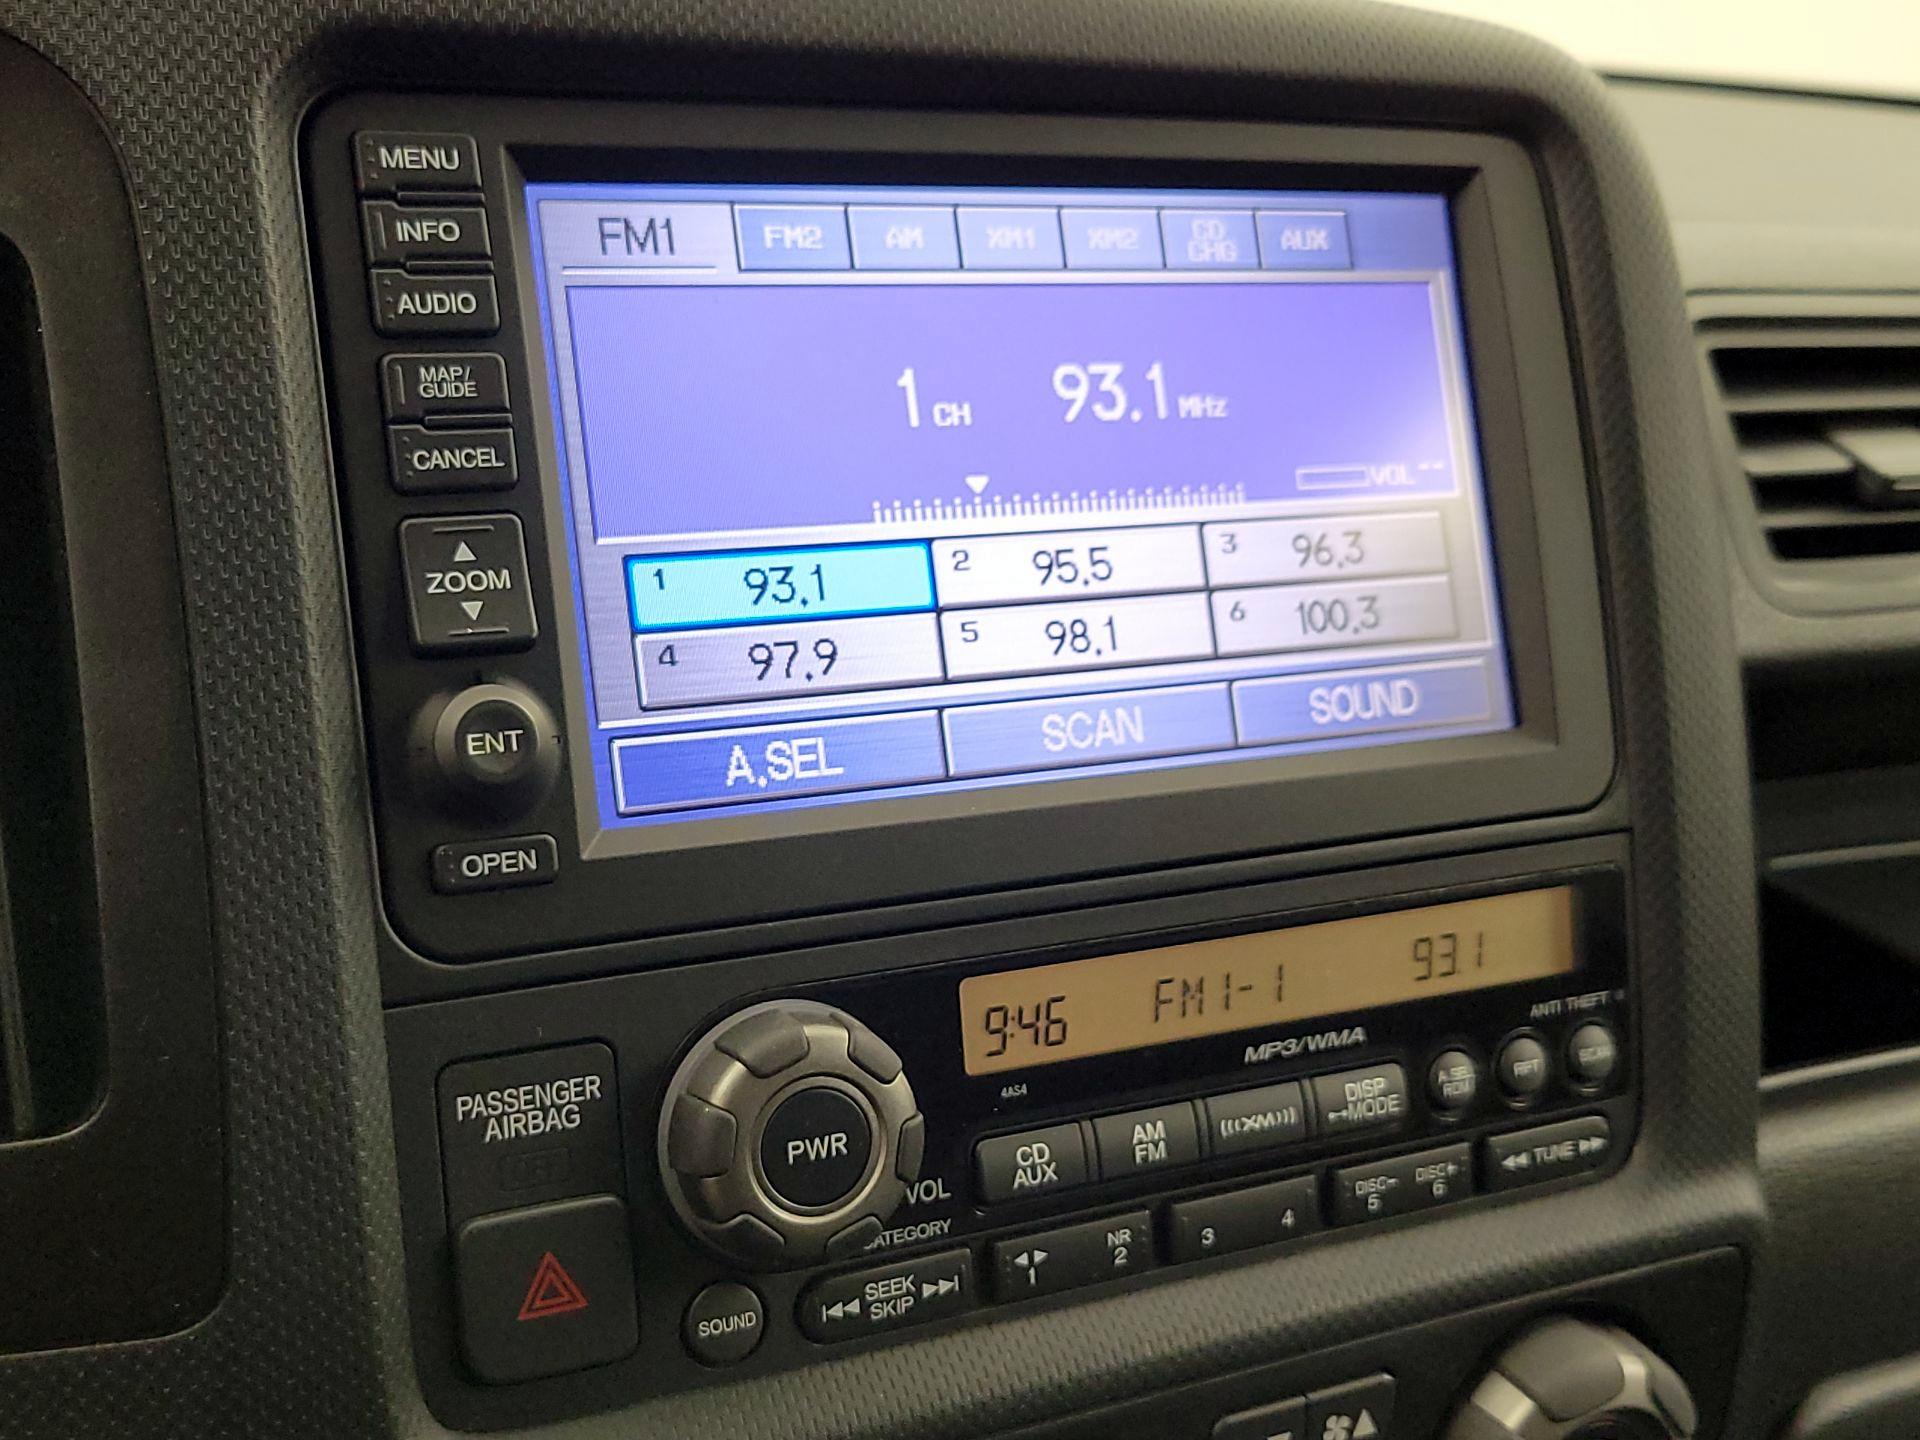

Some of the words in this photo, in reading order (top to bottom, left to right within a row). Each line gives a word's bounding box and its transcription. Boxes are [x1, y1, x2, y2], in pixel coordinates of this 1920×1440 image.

[380, 147, 460, 170] MENU
[397, 220, 461, 243] INFO
[599, 216, 676, 256] FM1
[763, 224, 823, 250] FM2
[884, 226, 925, 250] AM
[986, 227, 1036, 250] XM1
[1088, 227, 1139, 250] XM2
[1191, 218, 1226, 240] CD
[1280, 228, 1329, 251] AUX
[1188, 239, 1237, 262] CHG
[398, 292, 477, 315] AUDIO
[419, 366, 471, 384] MAP/
[419, 381, 478, 398] GUIDE
[897, 367, 920, 428] 1
[932, 401, 973, 427] CH
[1052, 361, 1169, 422] 93.1
[1178, 395, 1229, 419] MHz
[412, 448, 506, 472] CANCEL
[1369, 464, 1416, 486] VOL
[1221, 533, 1238, 554] 3
[1293, 530, 1366, 569] 96.3
[952, 550, 970, 572] 2
[1030, 546, 1114, 586] 95.5
[426, 569, 512, 595] ZOOM
[652, 568, 665, 591] 1
[743, 564, 826, 608] 93.1
[1229, 601, 1246, 622] 6
[1295, 595, 1380, 635] 100.3
[961, 621, 979, 643] 5
[1045, 615, 1118, 656] 98.1
[658, 644, 678, 667] 4
[748, 638, 838, 681] 97.9
[1309, 679, 1419, 726] SOUND
[1041, 706, 1145, 752] SCAN
[466, 729, 524, 756] ENT
[725, 736, 845, 788] A.SEL
[460, 849, 538, 877] OPEN
[985, 995, 1067, 1057] 9:46
[1244, 1026, 1367, 1065] MP3/WMA
[456, 1074, 602, 1122] PASSENGER
[1344, 1077, 1387, 1102] DISP
[1347, 1093, 1401, 1122] MODE
[485, 1104, 582, 1144] AIRBAG
[1132, 1119, 1167, 1145] AM
[787, 1132, 848, 1165] PWR
[1016, 1142, 1050, 1167] CD
[1134, 1139, 1168, 1165] FM
[1534, 1140, 1579, 1163] TUNE
[1013, 1161, 1059, 1190] AUX
[906, 1178, 952, 1204] VOL
[1432, 1179, 1447, 1199] 6
[1281, 1208, 1296, 1228] 4
[864, 1218, 952, 1250] ATEGORY
[1107, 1227, 1133, 1248] NR
[1201, 1227, 1216, 1248] 3
[1114, 1246, 1128, 1268] 2
[865, 1275, 916, 1301] SEEK
[1027, 1265, 1037, 1286] 1
[870, 1296, 915, 1321] SKIP
[698, 1311, 756, 1336] SOUND
